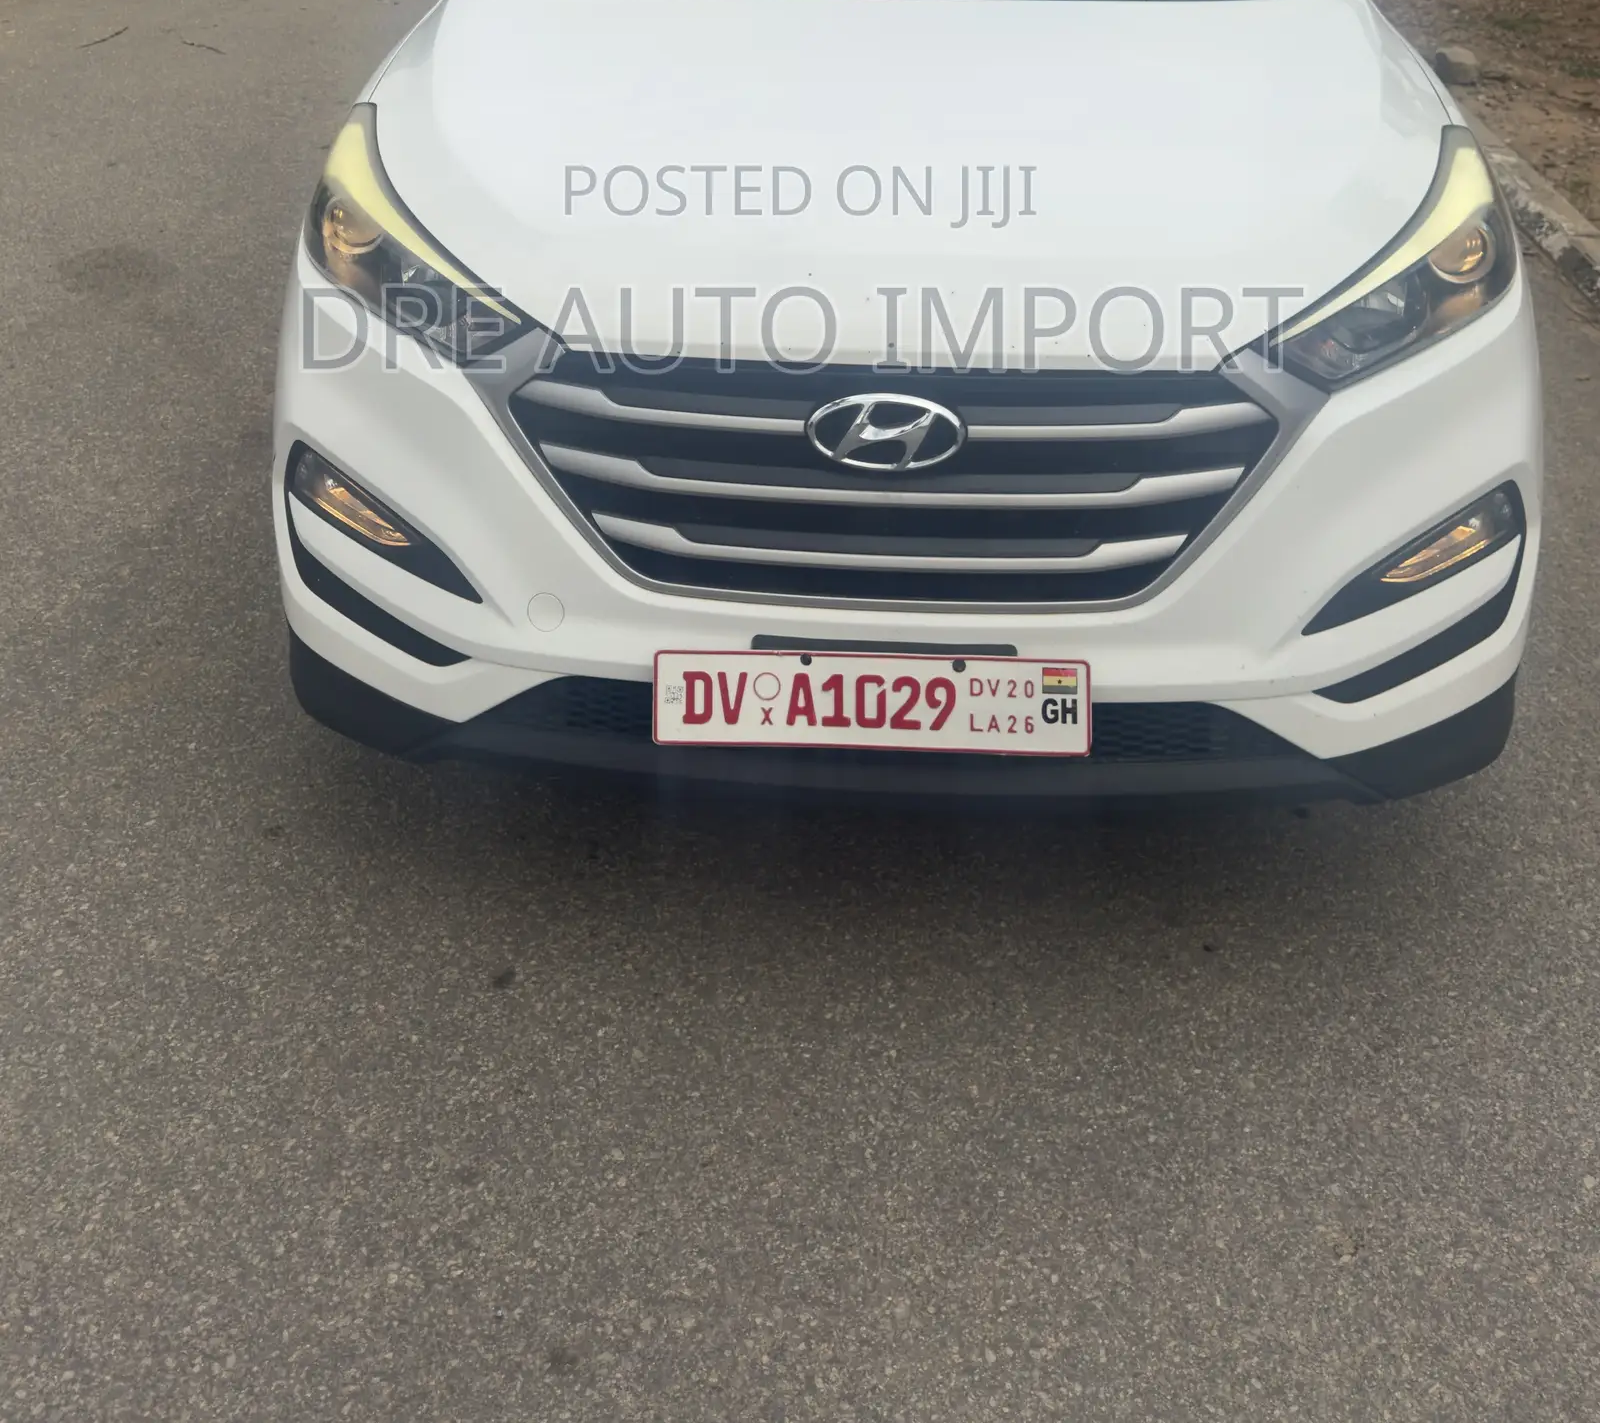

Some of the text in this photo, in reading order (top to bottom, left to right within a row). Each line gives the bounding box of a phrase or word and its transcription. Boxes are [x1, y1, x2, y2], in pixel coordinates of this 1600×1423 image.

[682, 670, 748, 725] DV
[786, 672, 957, 732] A1029
[1041, 698, 1078, 725] GH
